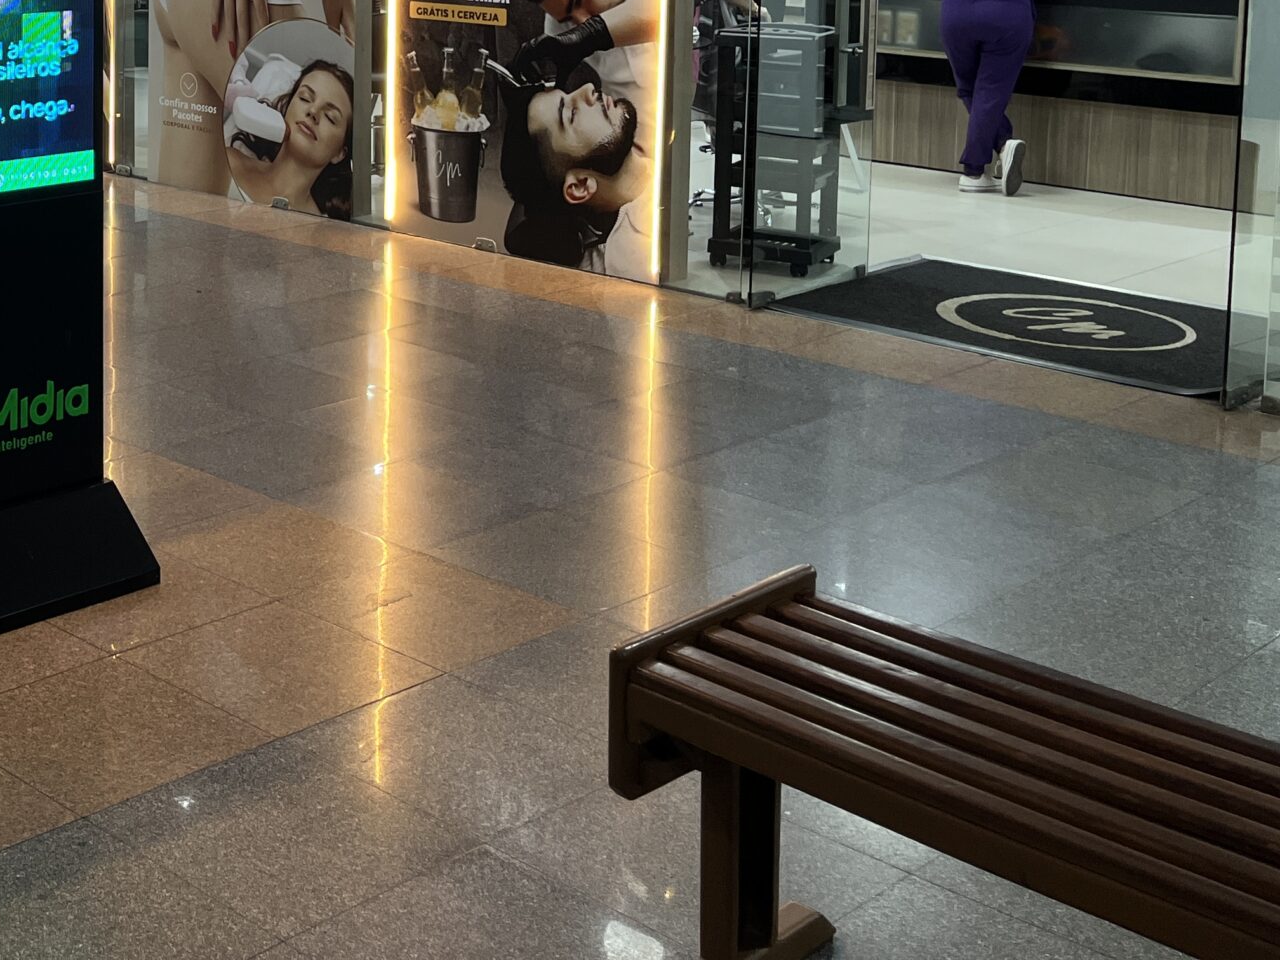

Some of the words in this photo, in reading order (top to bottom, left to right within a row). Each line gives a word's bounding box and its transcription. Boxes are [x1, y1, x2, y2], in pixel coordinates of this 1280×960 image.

[416, 5, 449, 19] GRÁTIS
[451, 8, 455, 18] 1
[457, 10, 499, 23] CERVEJA
[158, 95, 188, 110] Confira
[191, 102, 217, 114] nossos
[172, 108, 202, 123] Pacotes
